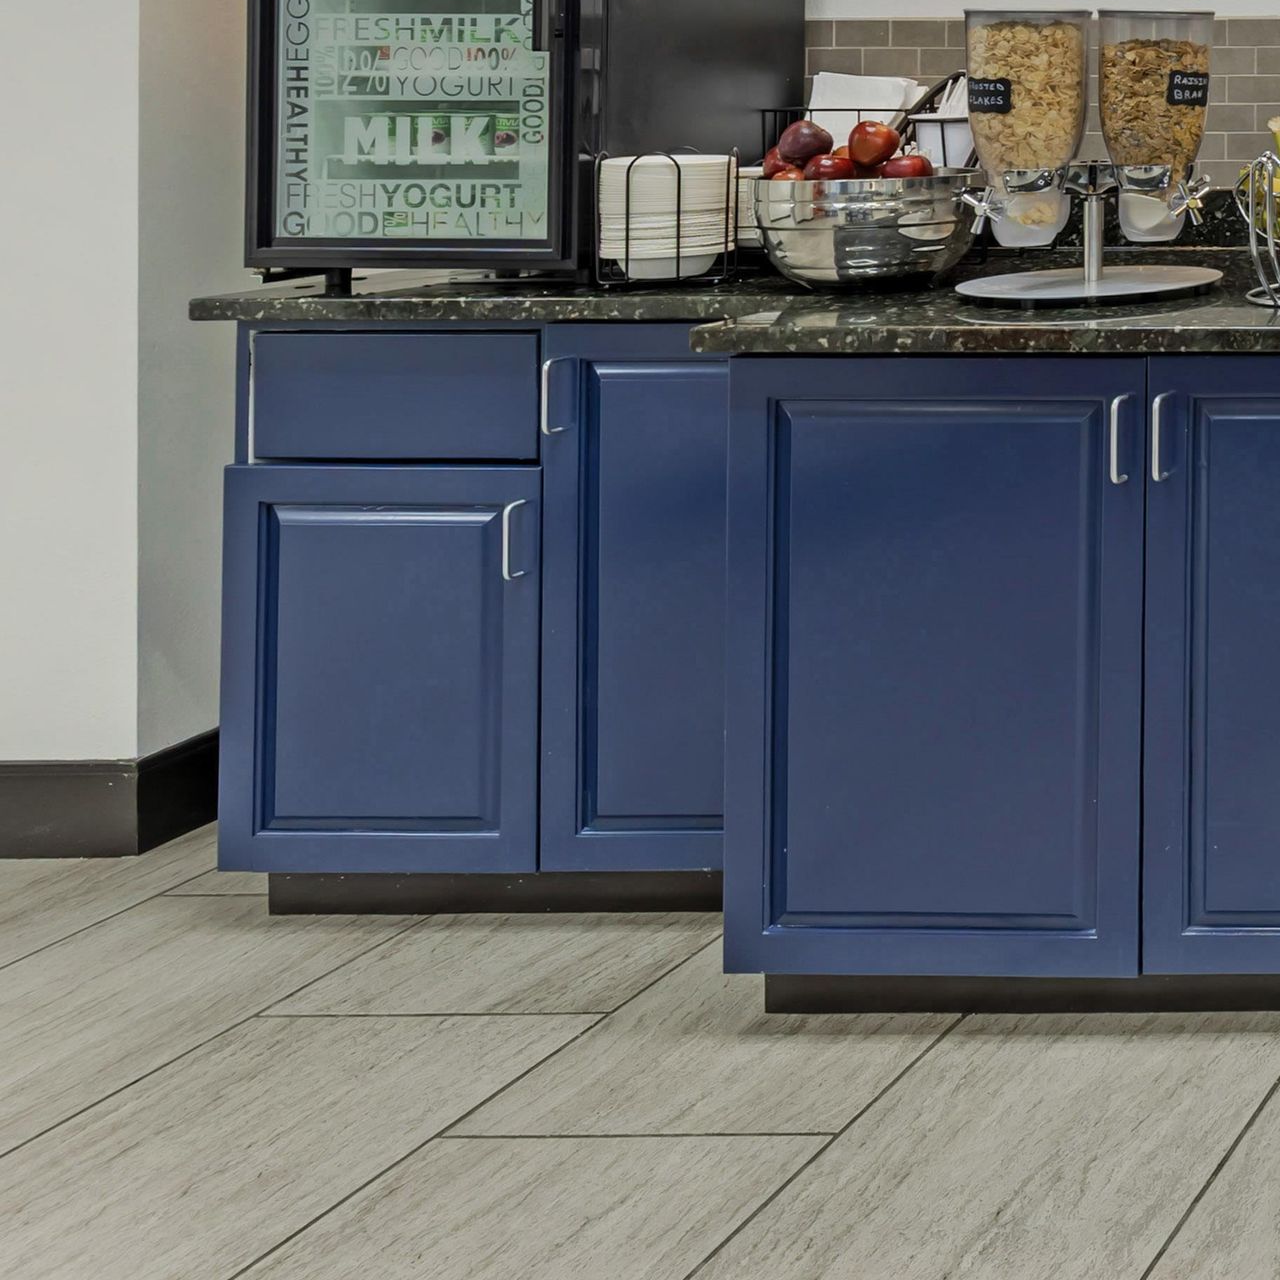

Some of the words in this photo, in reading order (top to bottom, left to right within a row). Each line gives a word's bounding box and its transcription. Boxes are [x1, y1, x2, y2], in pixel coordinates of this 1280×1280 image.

[315, 17, 415, 41] FRESH
[419, 17, 522, 43] MILK
[393, 46, 464, 71] GOOD
[968, 94, 1004, 106] FLAKES
[1173, 89, 1204, 101] BRAN
[285, 66, 310, 182] HEALTHY
[522, 83, 545, 145] GOOD
[343, 115, 491, 165] MILK
[379, 183, 523, 209] YOGURT
